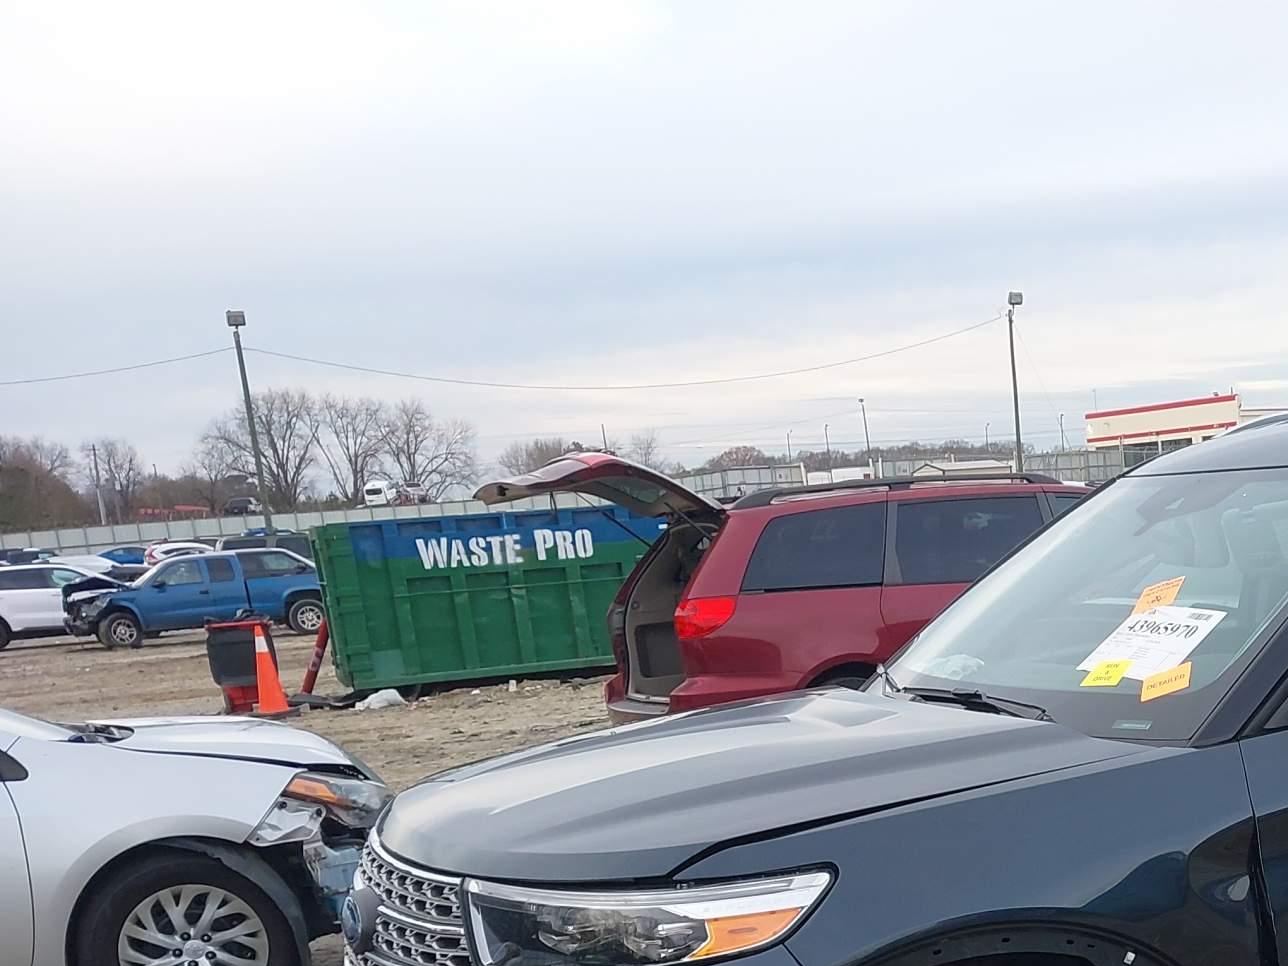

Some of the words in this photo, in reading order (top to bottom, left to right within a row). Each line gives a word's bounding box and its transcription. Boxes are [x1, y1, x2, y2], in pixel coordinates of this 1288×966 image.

[415, 534, 524, 570] WASTE
[533, 528, 594, 561] PRO
[1127, 619, 1199, 639] 43965970
